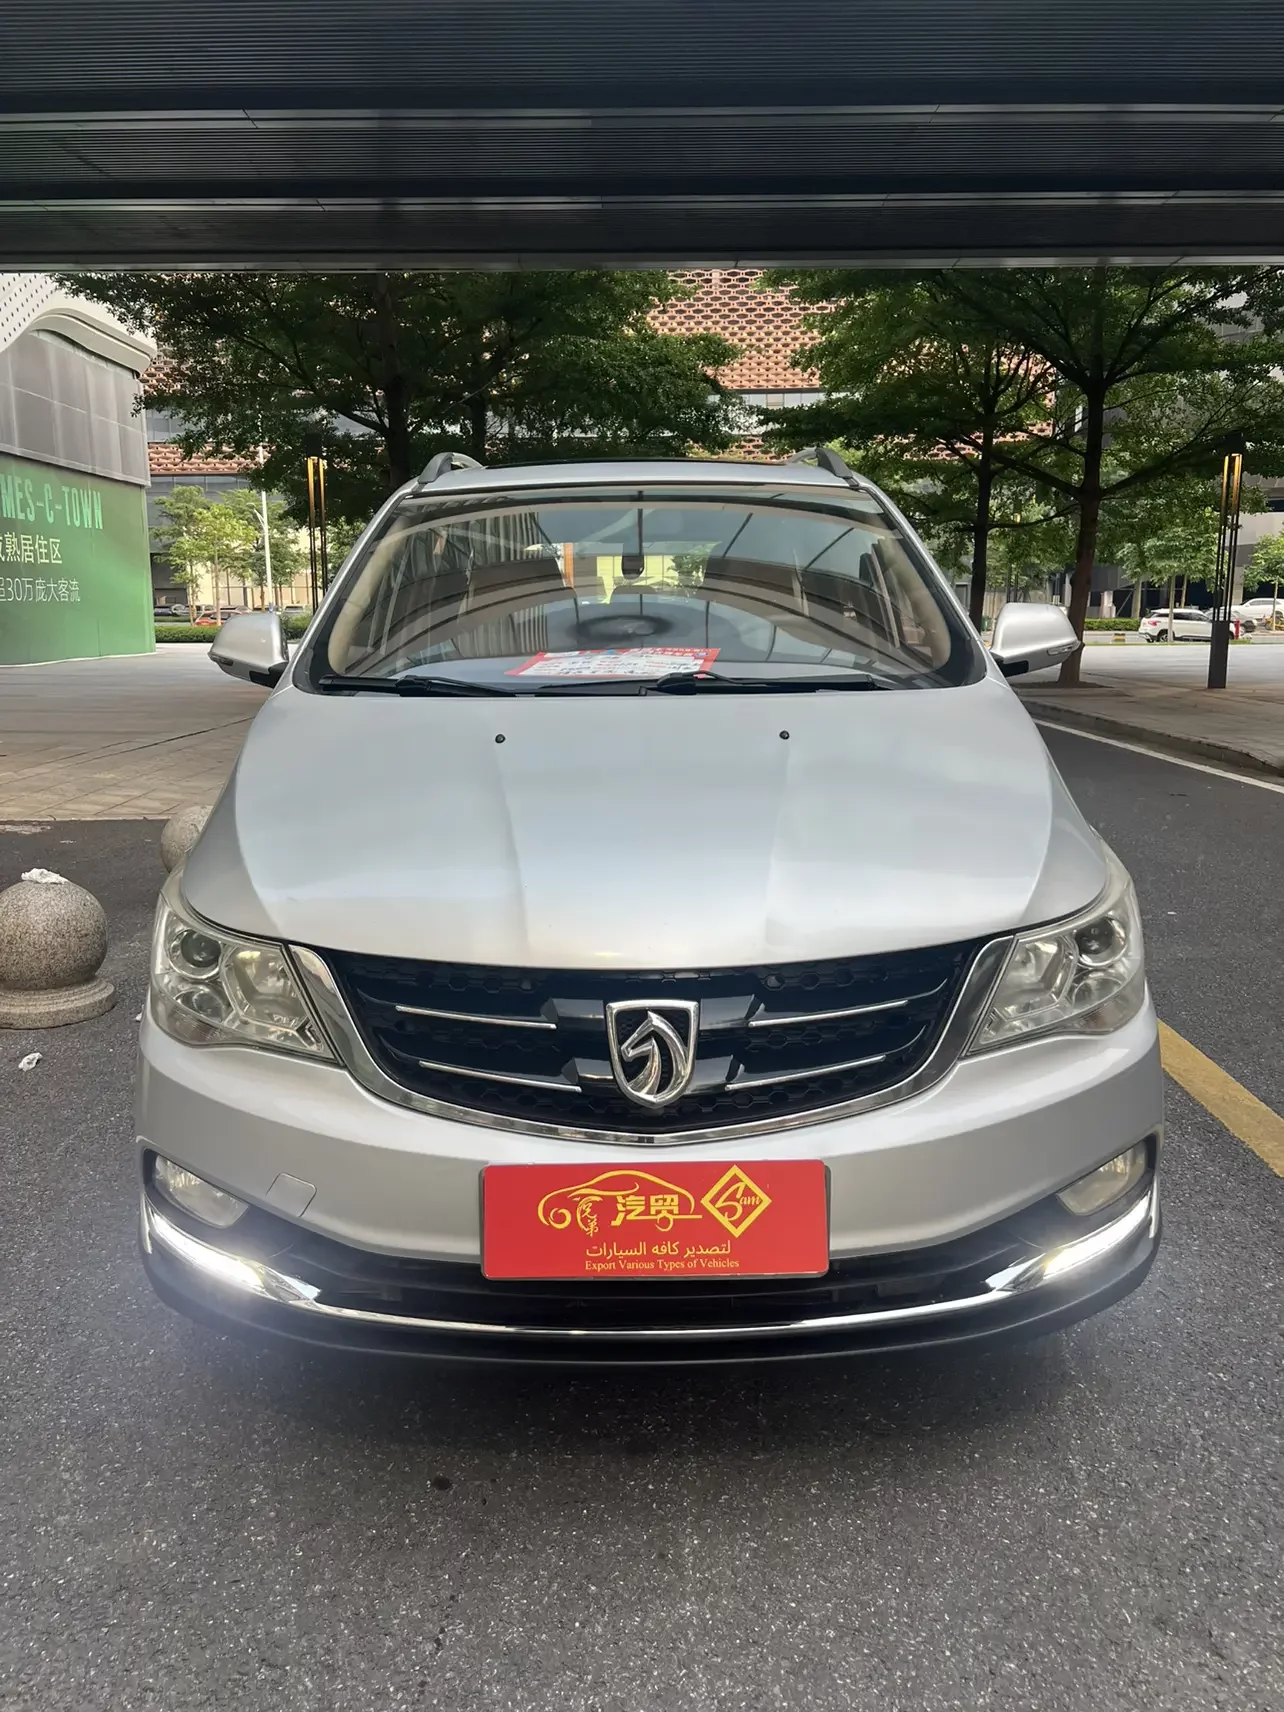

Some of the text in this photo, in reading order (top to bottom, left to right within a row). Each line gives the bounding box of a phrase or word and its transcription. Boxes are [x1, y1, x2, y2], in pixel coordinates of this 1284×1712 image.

[714, 1181, 761, 1222] Sam
[585, 1241, 647, 1259] السيارات
[684, 1240, 731, 1258] لتصدير
[585, 1258, 740, 1272] Export Various Types of Vehicles
